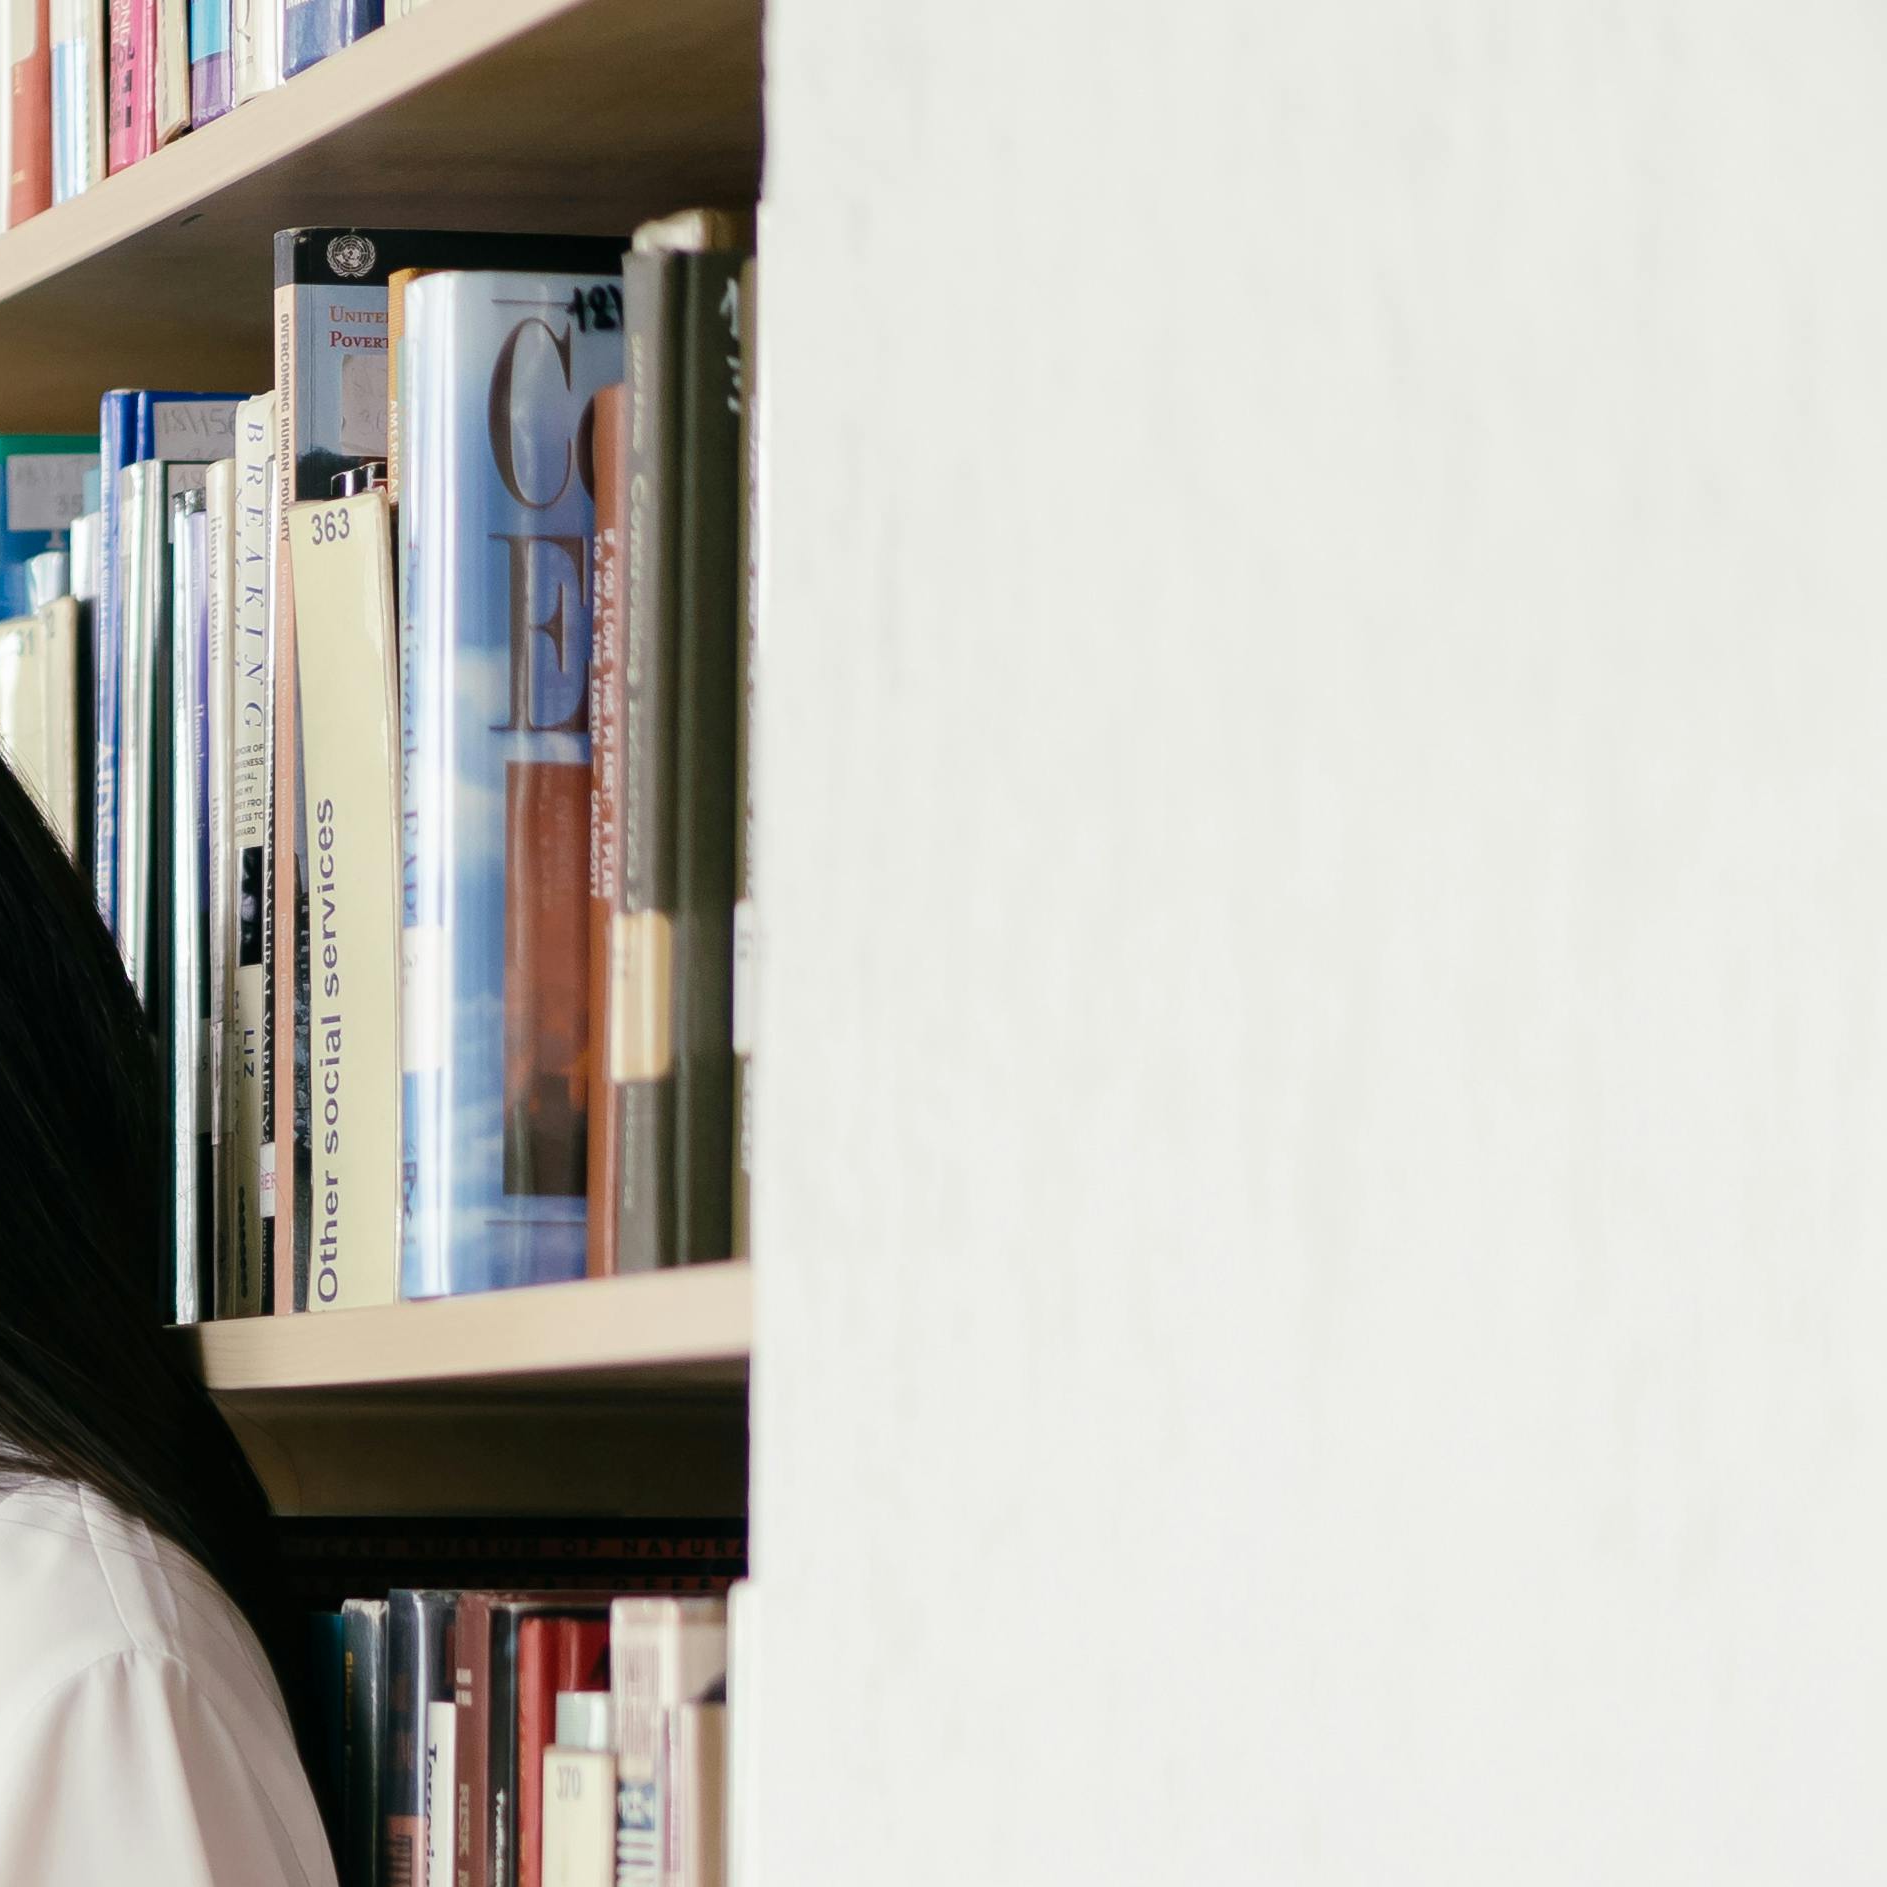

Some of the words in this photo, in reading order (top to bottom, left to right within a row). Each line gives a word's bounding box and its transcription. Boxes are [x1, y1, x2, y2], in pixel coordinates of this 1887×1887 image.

[279, 313, 290, 413] OVERCOMING
[280, 418, 290, 474] HUMAN
[388, 399, 399, 503] AMERICAN
[280, 478, 290, 543] POVERTY
[310, 508, 351, 544] 363
[245, 422, 265, 728] BREAKING
[593, 534, 602, 561] TO
[603, 556, 616, 599] YOU
[592, 631, 601, 668] THE
[603, 607, 616, 661] LOVE
[592, 678, 601, 746] EARTH
[602, 671, 615, 717] THIS
[317, 796, 339, 1000] services
[601, 842, 613, 898] PLAN
[263, 869, 271, 1001] NATURAL
[243, 1029, 256, 1080] LIZ
[262, 1011, 270, 1143] VARIETY?
[320, 1011, 342, 1156] social
[317, 1169, 340, 1304] Other
[560, 1536, 601, 1557] OF
[457, 1782, 470, 1857] RISK
